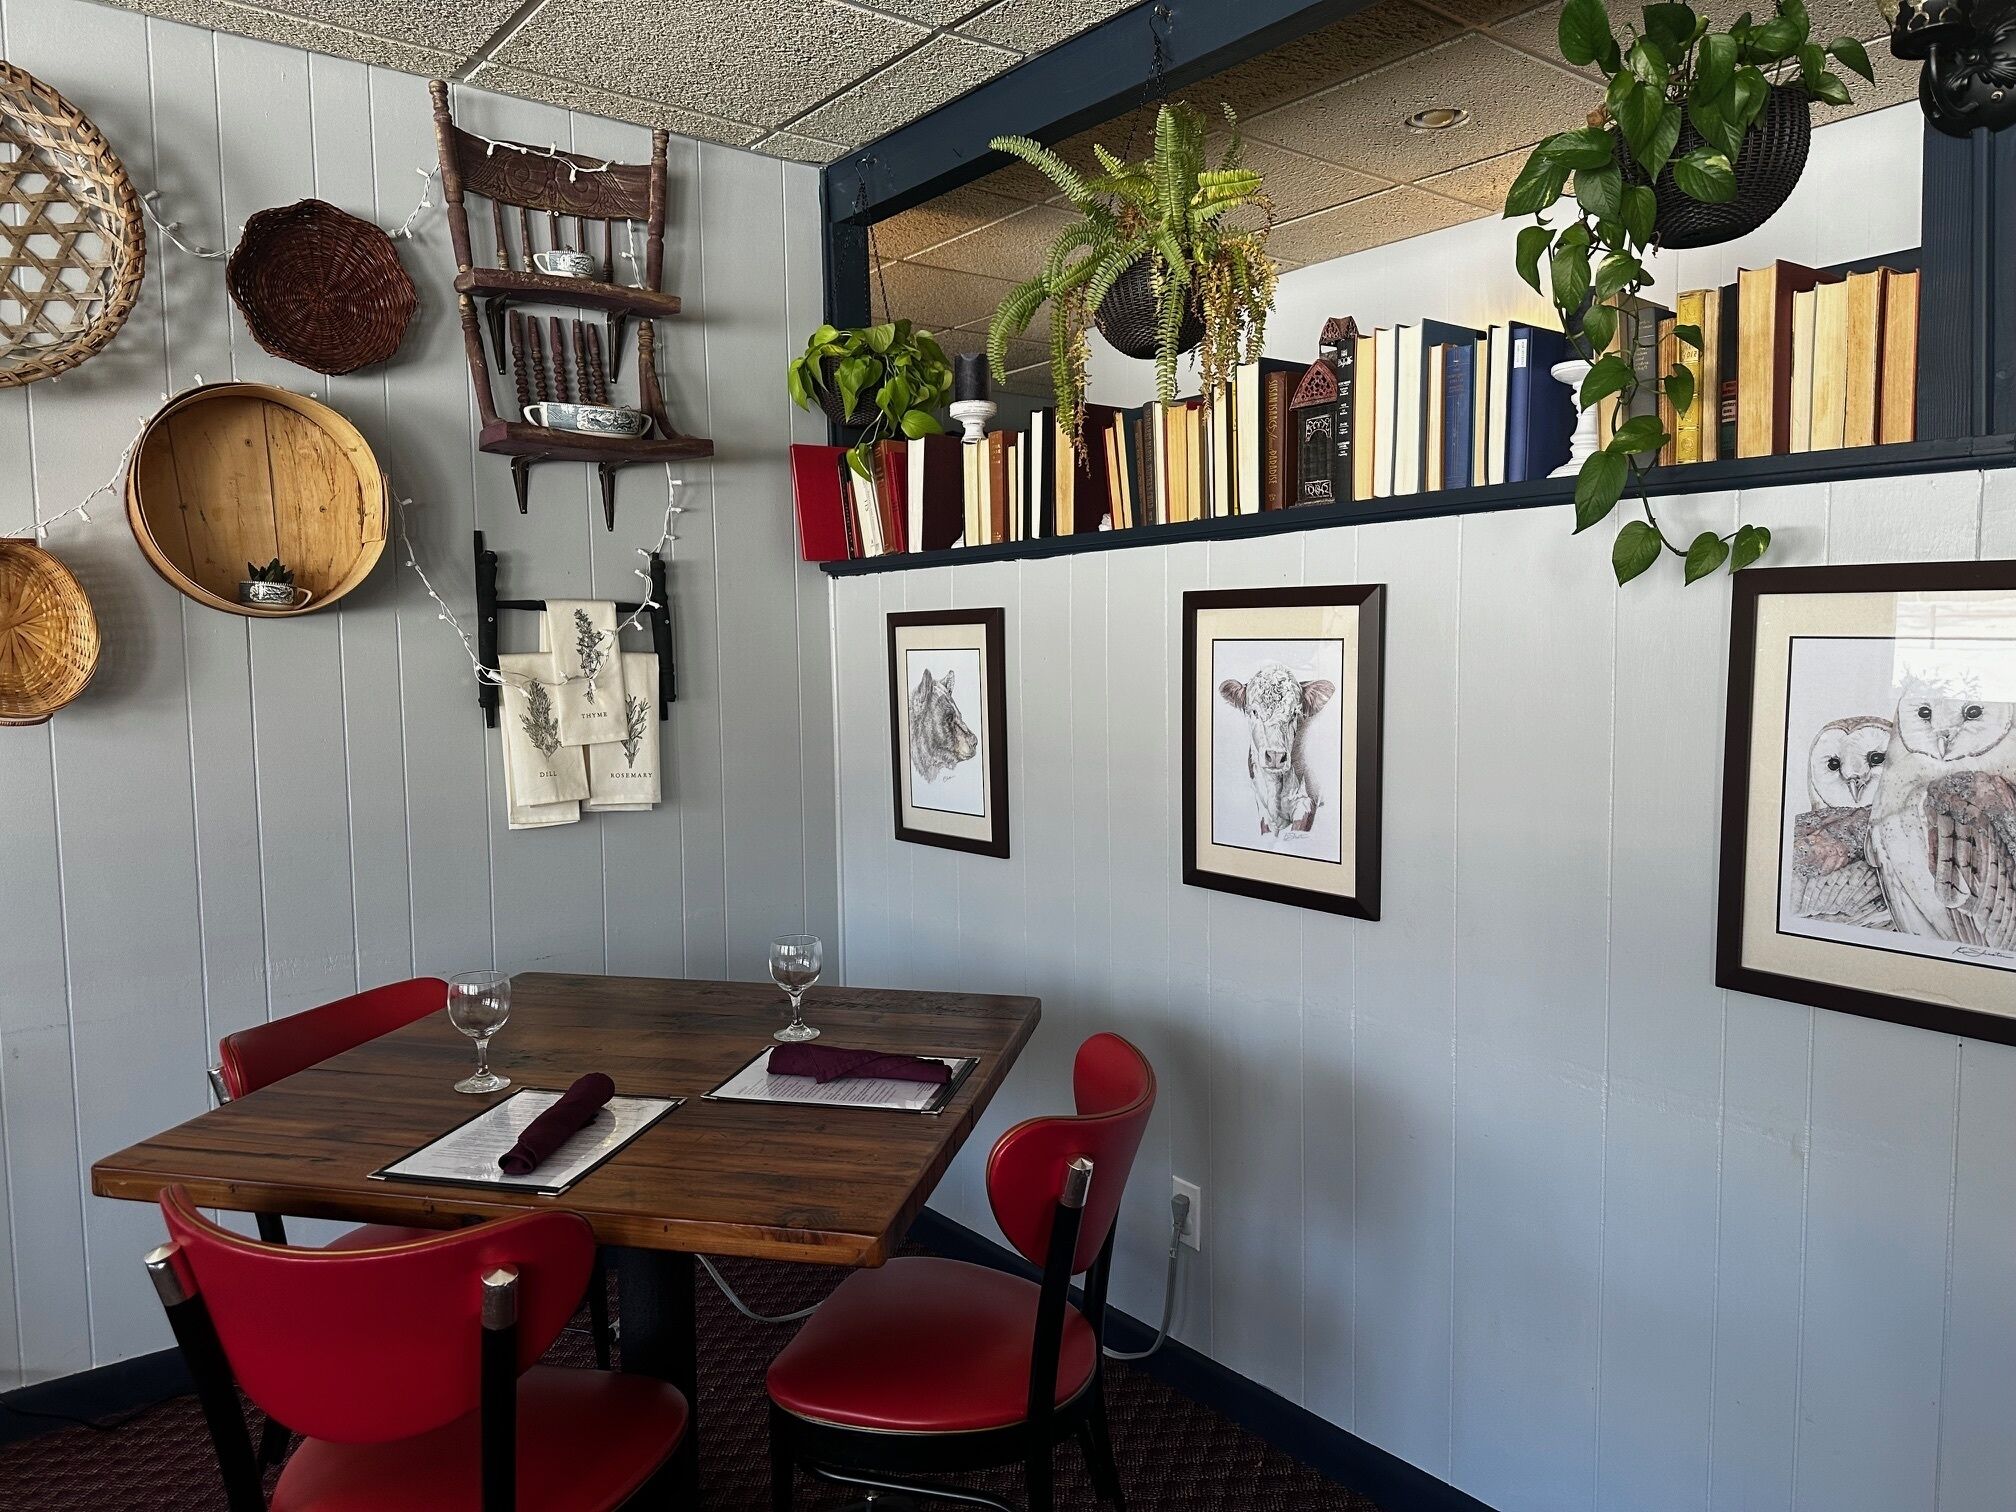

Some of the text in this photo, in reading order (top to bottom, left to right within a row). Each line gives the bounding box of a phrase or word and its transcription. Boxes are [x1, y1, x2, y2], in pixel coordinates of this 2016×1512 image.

[1268, 379, 1278, 403] SUSAN
[1268, 403, 1278, 429] ISAACS
[1268, 449, 1278, 485] PARADISE
[581, 711, 608, 719] THYME
